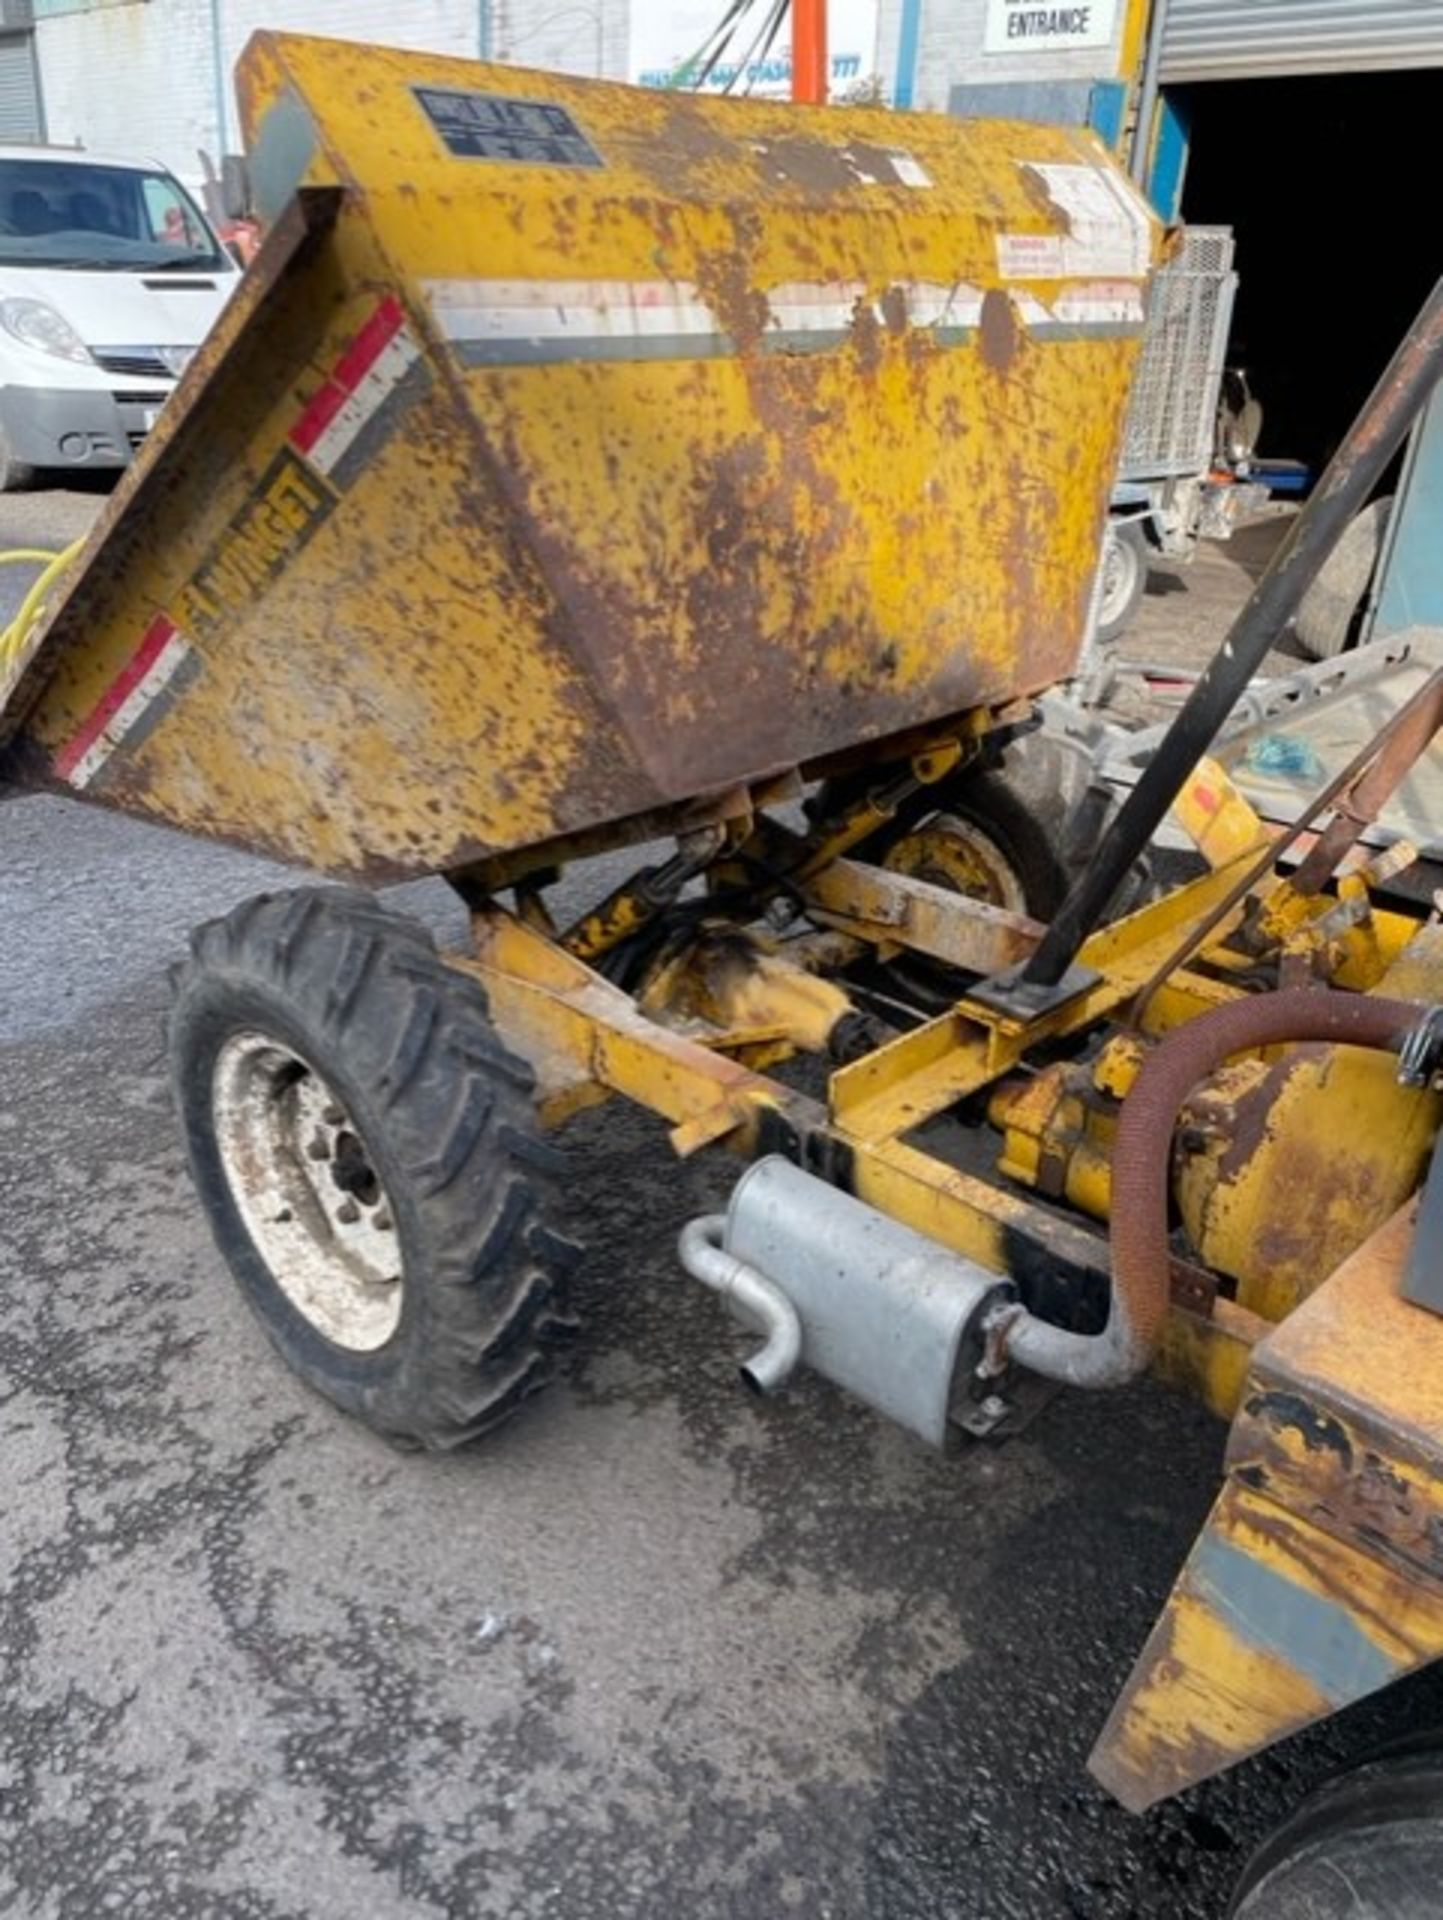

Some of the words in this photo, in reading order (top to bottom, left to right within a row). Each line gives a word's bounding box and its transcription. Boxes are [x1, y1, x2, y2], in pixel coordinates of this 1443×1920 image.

[1007, 6, 1090, 38] ENTRANCE
[833, 54, 860, 78] 777
[198, 461, 322, 606] WINGET
